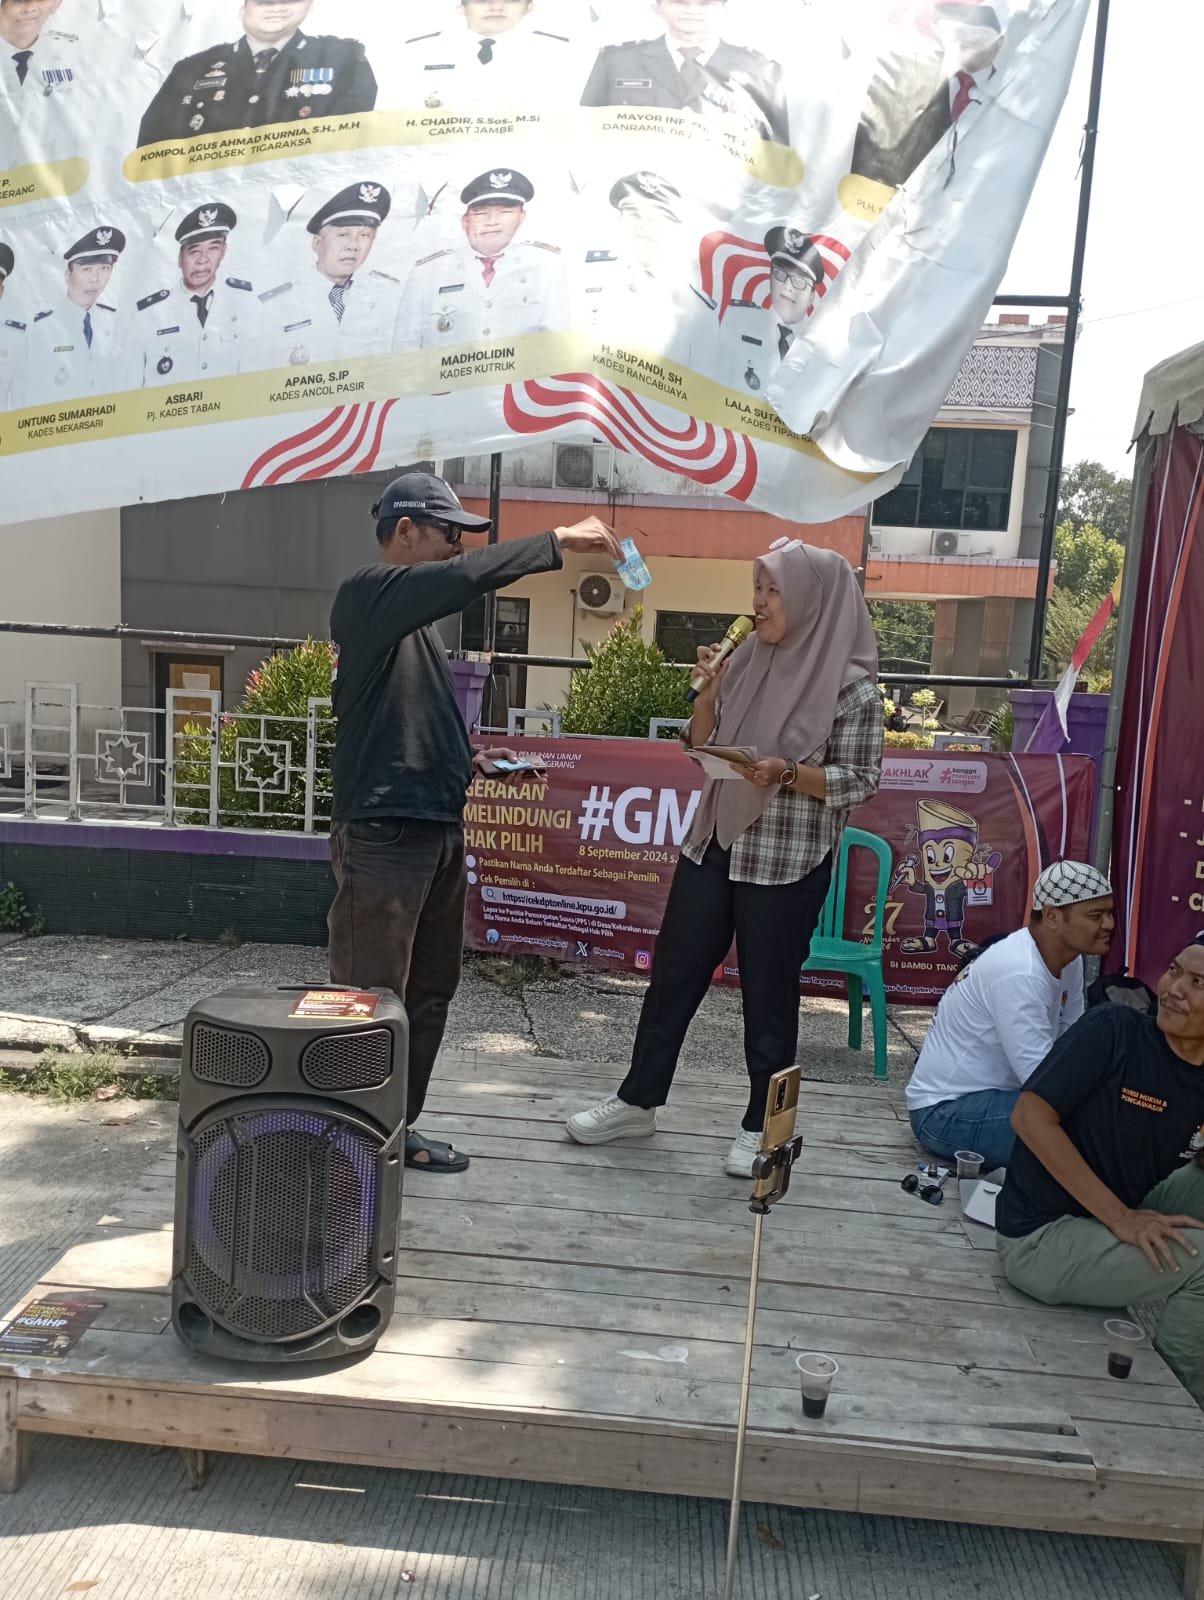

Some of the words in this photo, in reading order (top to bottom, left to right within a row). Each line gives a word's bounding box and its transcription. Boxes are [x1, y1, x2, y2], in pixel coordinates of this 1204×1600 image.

[406, 119, 418, 127] H.
[421, 117, 473, 126] CHAIDIR,
[616, 113, 663, 122] MAYOR
[428, 126, 471, 136] CAMAT
[474, 125, 514, 134] JAMBE
[602, 123, 665, 134] DANRAMIL
[140, 146, 186, 163] KOMPOL
[188, 140, 218, 154] AGUS
[220, 135, 262, 150] AHMAD
[263, 127, 310, 142] KURNIA,
[338, 121, 361, 131] M.H
[188, 148, 246, 164] KAPOLSEK
[250, 137, 313, 155] TIGARAKSA
[441, 347, 515, 367] MADHOLIDIN
[601, 344, 613, 356] H.
[616, 349, 665, 380] SUPANDI,
[667, 372, 682, 386] SH
[439, 366, 473, 379] KADES
[474, 360, 516, 375] KUTRUK
[592, 353, 625, 373] KADES
[626, 367, 688, 400] RANCABUAYA
[284, 374, 326, 388] APANG,
[328, 370, 350, 382] S.IP
[165, 391, 204, 406] ASBARI
[269, 390, 300, 403] KADES
[302, 386, 335, 399] ANCOL
[336, 381, 365, 395] PASIR
[159, 406, 189, 418] KADES
[190, 402, 221, 414] TABAN
[725, 397, 752, 414] LALA
[17, 415, 56, 430] UNTUNG
[58, 404, 116, 422] SUMARHADI
[740, 415, 771, 431] KADES
[27, 428, 54, 440] KADES
[55, 419, 104, 434] MEKARSARI
[556, 753, 581, 761] UMUM
[463, 804, 572, 830] MELINDUNGI
[463, 828, 498, 850] HAK
[500, 831, 544, 854] PILIH
[578, 846, 586, 856] 8
[587, 845, 641, 860] September
[642, 850, 668, 862] 2024
[479, 857, 509, 870] Pastikan
[510, 860, 532, 872] Nama
[533, 862, 554, 874] Anda
[554, 863, 592, 877] Terdaftar
[592, 867, 626, 881] Sebagai
[627, 871, 660, 883] Pemilih
[480, 873, 493, 884] Cek
[494, 875, 522, 887] Pemilih
[522, 878, 530, 888] di
[900, 961, 933, 971] BAMBU
